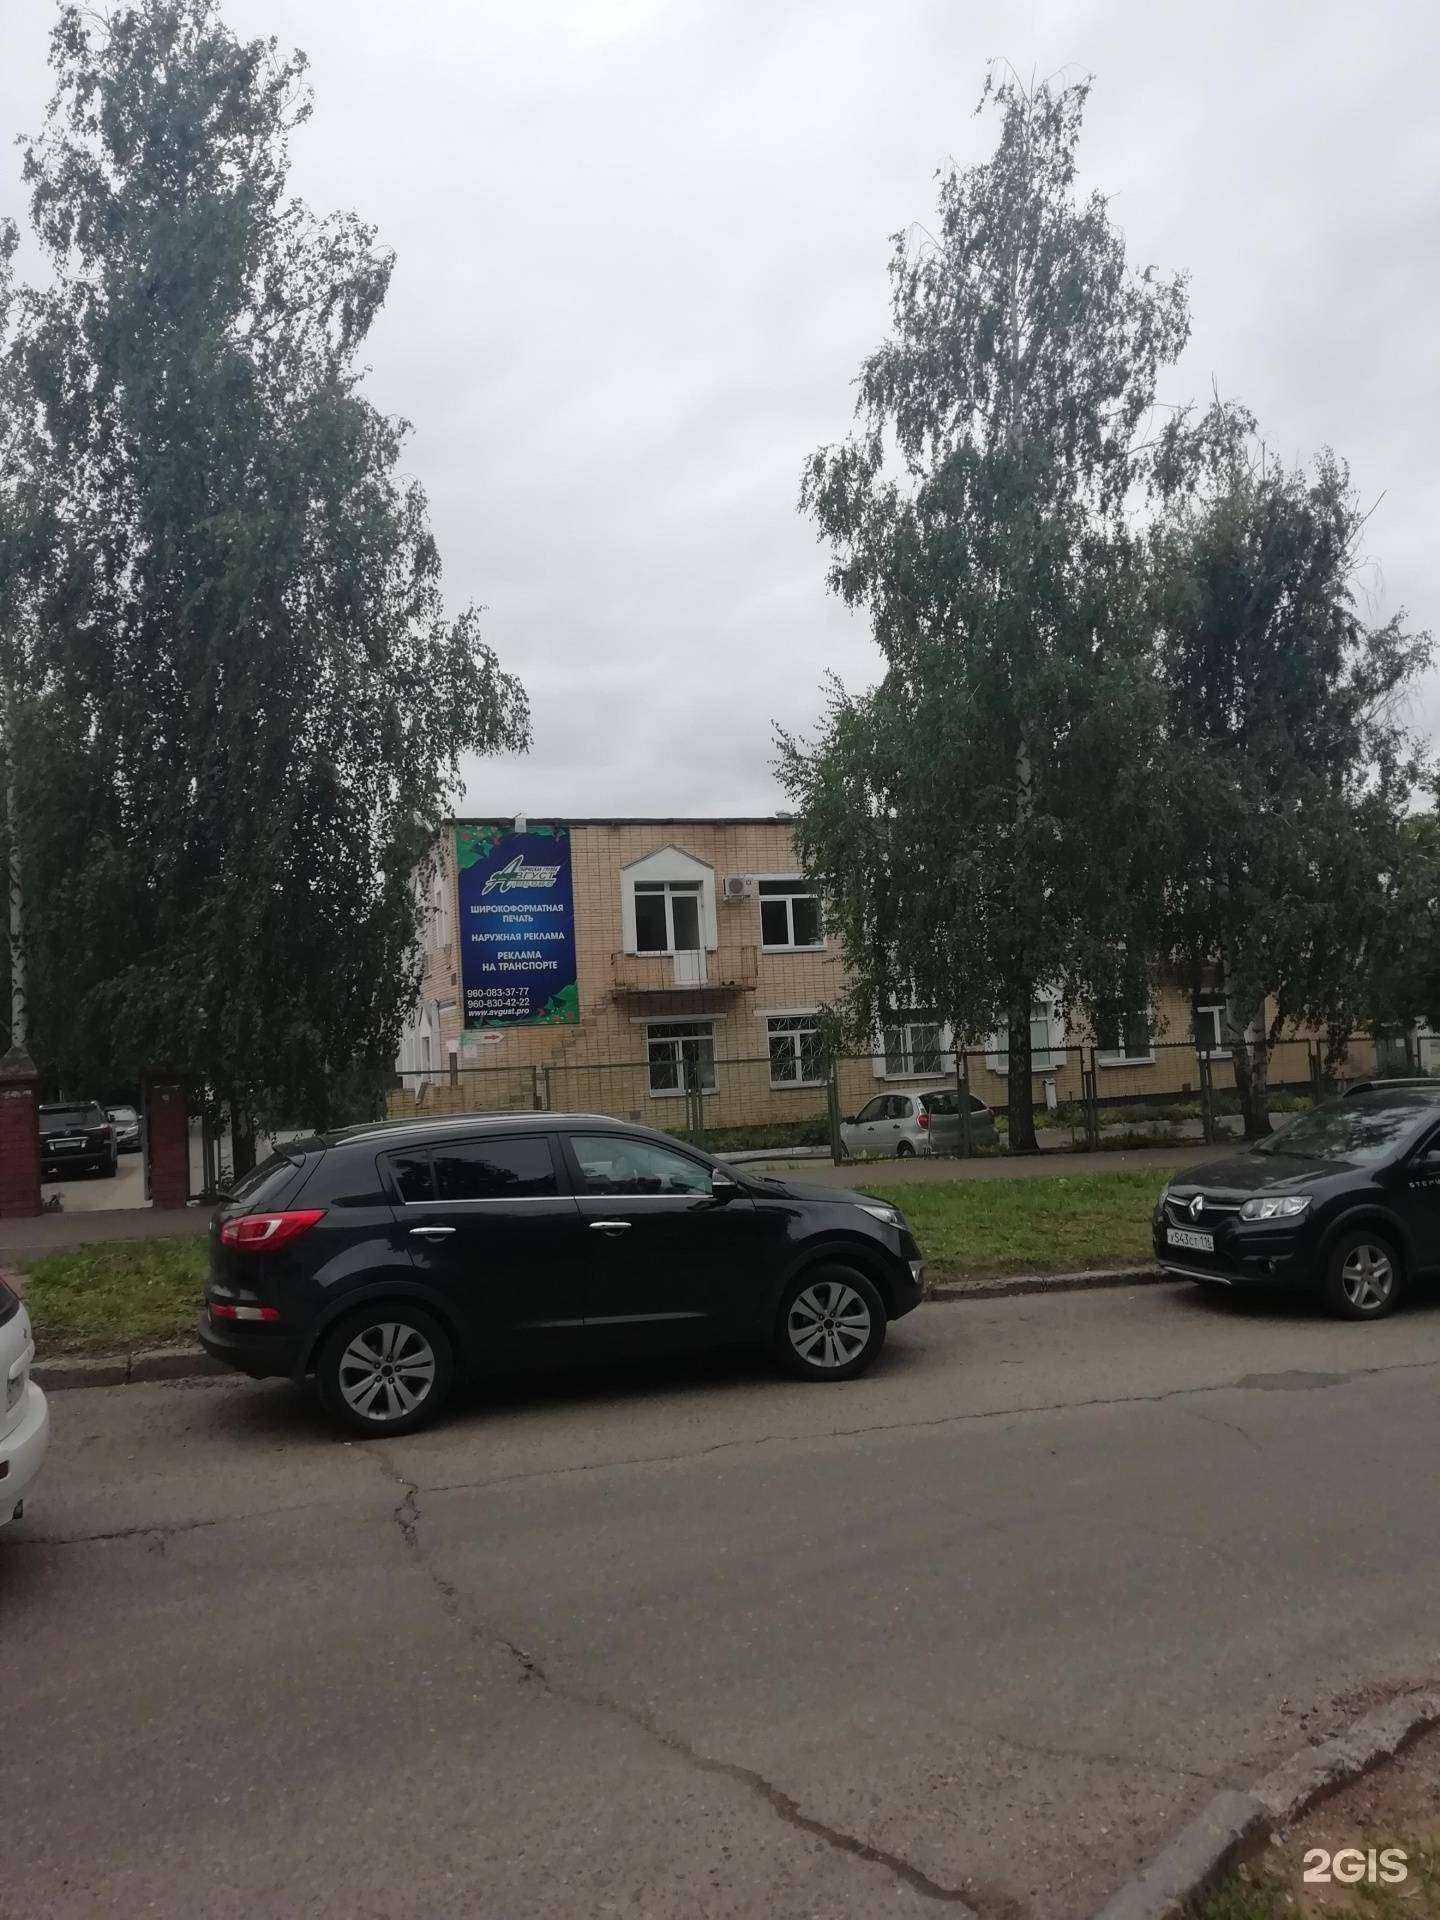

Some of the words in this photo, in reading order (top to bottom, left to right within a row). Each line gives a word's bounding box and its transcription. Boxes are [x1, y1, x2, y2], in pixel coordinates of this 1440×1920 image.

[470, 904, 564, 914] ШИРОКОФОРМАТНАЯ
[503, 914, 534, 923] ПЕЧАТЬ
[471, 933, 521, 942] НАРУЖНАЯ
[523, 931, 565, 940] РЕКЛАМА
[497, 950, 542, 960] РЕКЛАМА
[482, 962, 497, 972] НА
[498, 960, 558, 971] ТРАНСПОРТЕ
[467, 987, 529, 998] 960-083-37-77
[467, 997, 530, 1009] 960-830-42-22
[468, 1008, 530, 1017] www.avgust.pro
